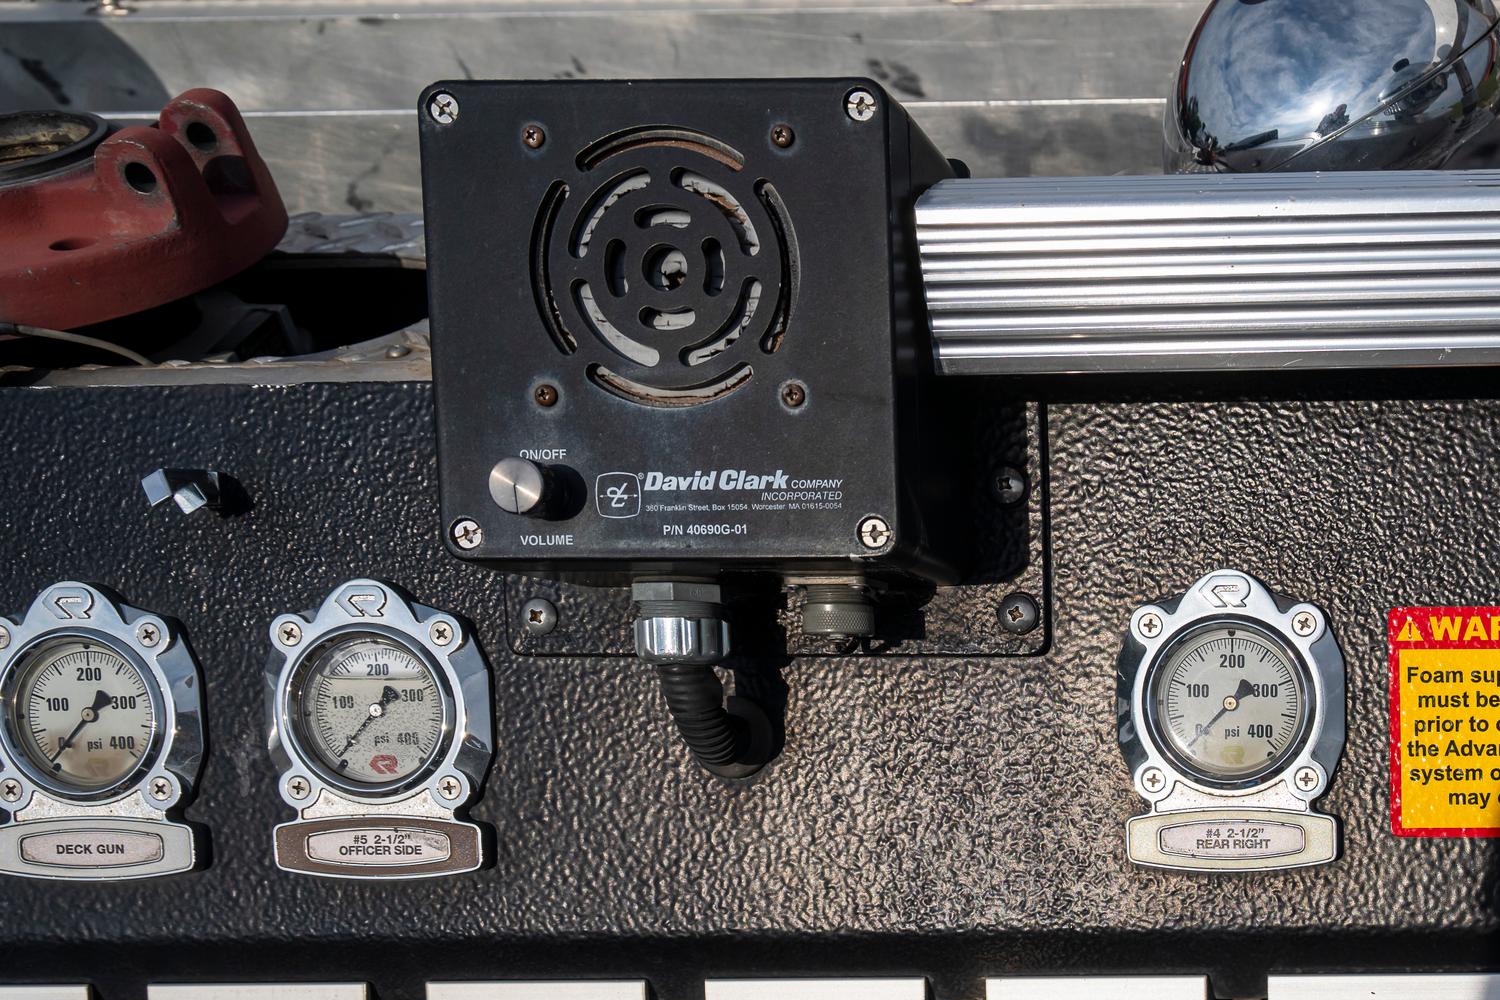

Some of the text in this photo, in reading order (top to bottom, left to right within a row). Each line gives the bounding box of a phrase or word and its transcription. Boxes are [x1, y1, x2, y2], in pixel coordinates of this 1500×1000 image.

[519, 449, 567, 460] ON/OFF
[644, 469, 843, 492] David Clark COMPANY
[761, 490, 842, 501] INCORPORATED
[646, 504, 658, 512] 360
[660, 504, 686, 512] Franklin
[688, 504, 711, 512] Street,
[712, 504, 726, 512] Box
[788, 502, 800, 510] MA
[663, 524, 748, 536] P/N 40690G-01
[520, 534, 574, 546] VOLUME
[1219, 654, 1246, 669] 200
[76, 667, 102, 682] 200
[1407, 666, 1466, 684] Foam
[1186, 682, 1278, 698] 100 300
[46, 696, 137, 712] 100 300
[1418, 691, 1471, 708] must
[1476, 690, 1500, 708] be
[1224, 724, 1274, 740] psi 400
[1414, 716, 1464, 736] prior
[1469, 716, 1491, 733] to
[87, 736, 135, 753] psi 400
[1406, 740, 1440, 758] the
[1409, 764, 1484, 787] system
[1448, 791, 1491, 810] may
[353, 834, 370, 846] #5
[1206, 828, 1222, 838] #4
[56, 843, 125, 856] DECK GUN
[338, 844, 424, 857] OFFICER SIDE
[1196, 838, 1270, 850] REAR RIGHT
